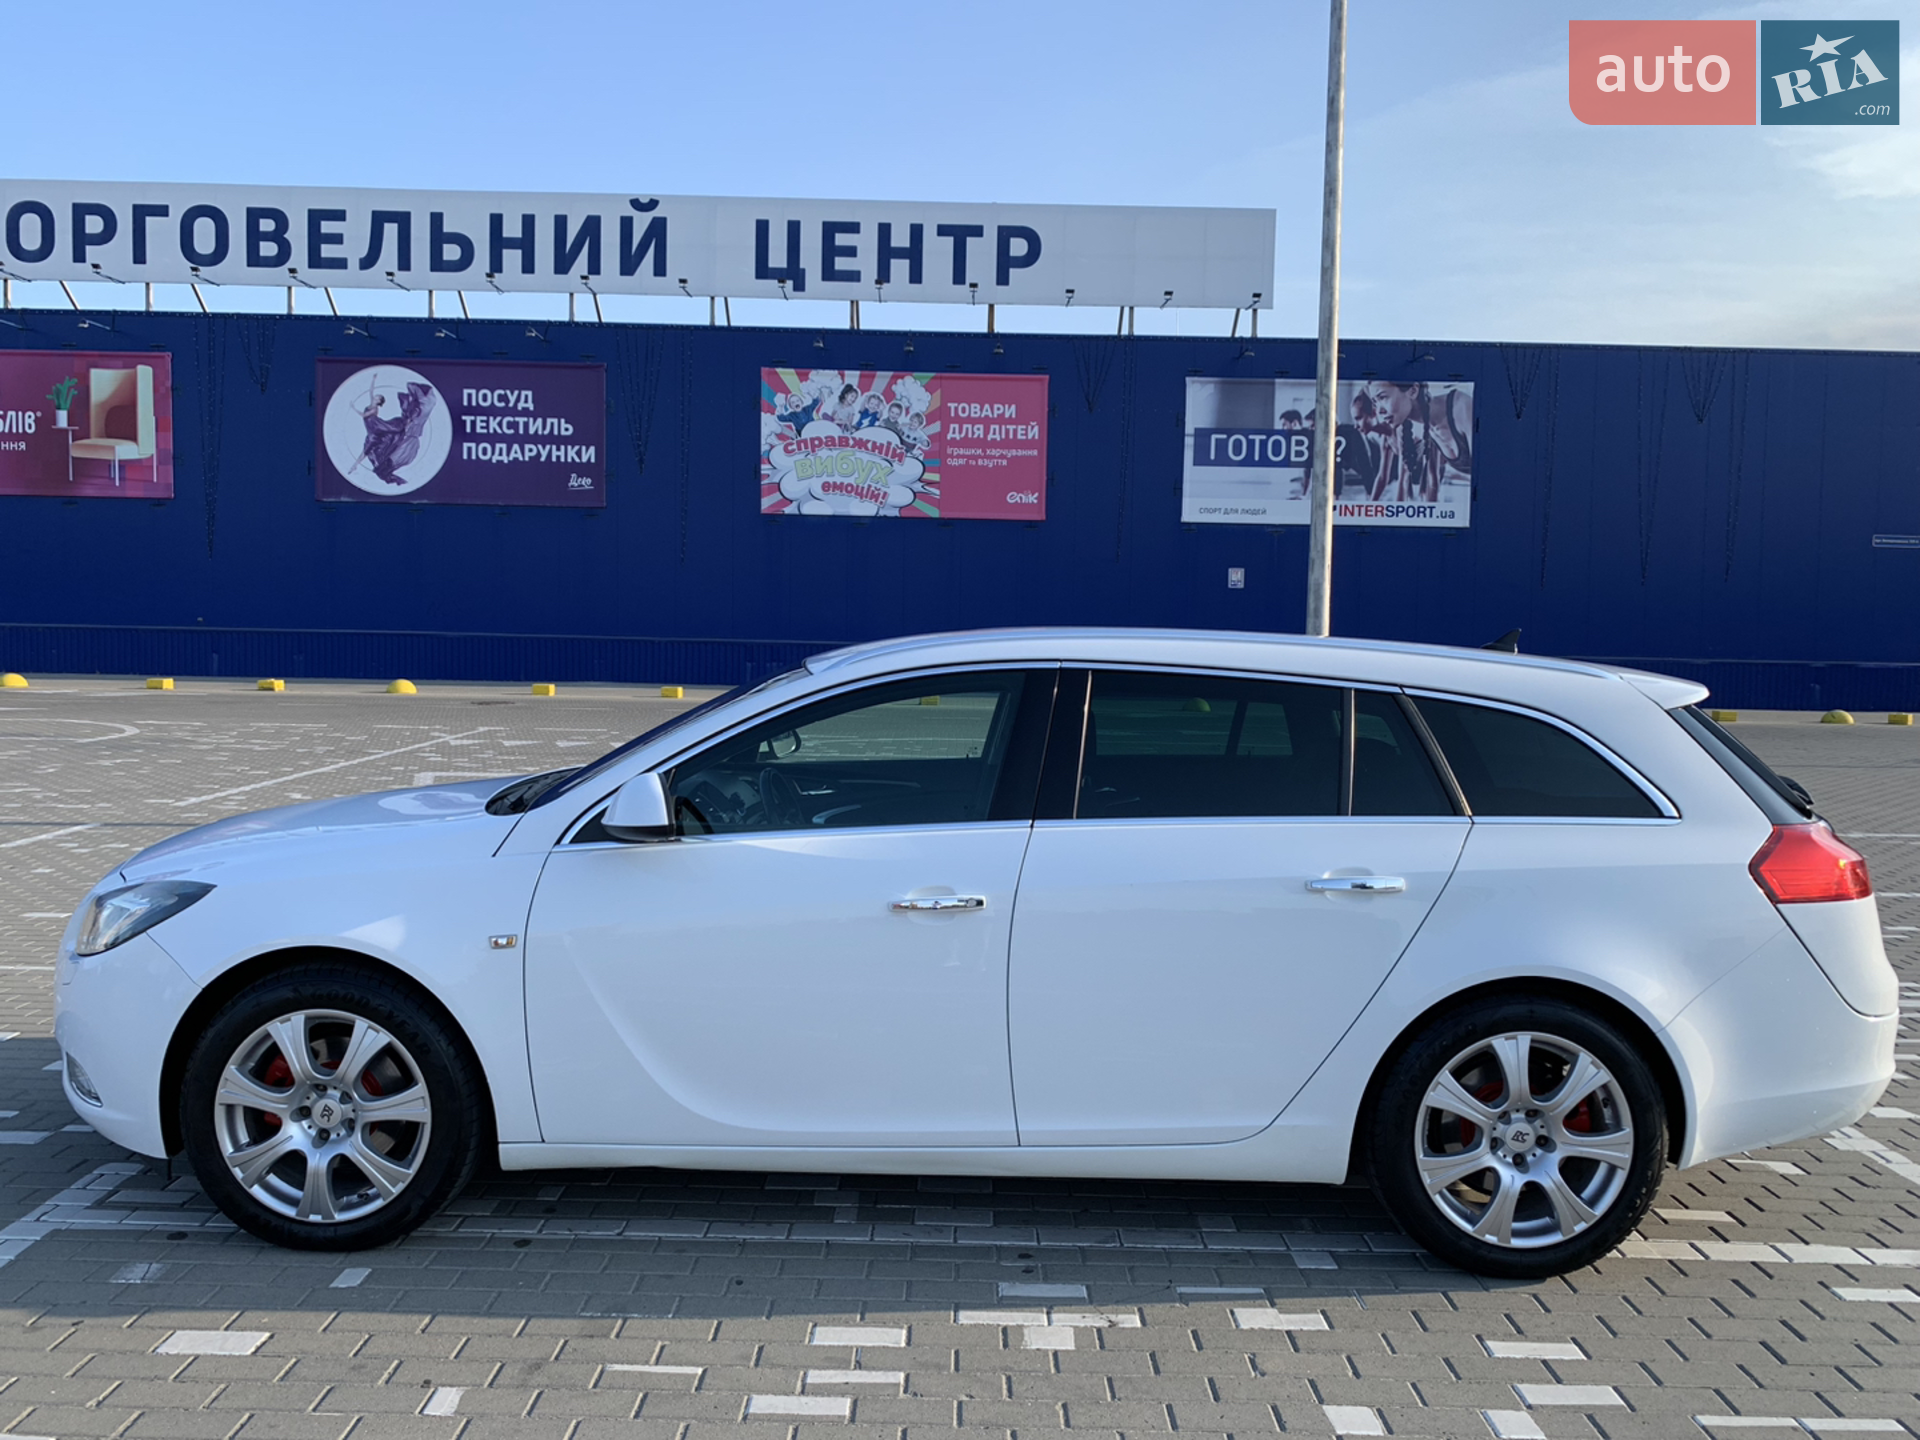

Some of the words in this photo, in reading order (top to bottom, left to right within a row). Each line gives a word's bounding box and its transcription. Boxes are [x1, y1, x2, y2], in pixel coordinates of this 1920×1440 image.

[4, 197, 668, 278] ОРГОВЕЛЬНИЙ
[754, 218, 1042, 292] ЦЕНТР
[462, 388, 535, 411] ПОСУД
[947, 402, 1017, 419] ТОВАРИ
[461, 415, 574, 436] ТЕКСТИЛЬ
[946, 423, 984, 441] ДЛЯ
[987, 421, 1039, 441] ДІТЕЙ
[462, 442, 596, 464] ПОДАРУНКИ
[783, 434, 907, 465] справжній
[1209, 434, 1346, 462] ГОТОВ?
[793, 450, 894, 487] вибух
[1338, 504, 1456, 520] INTERSPORT.ua
